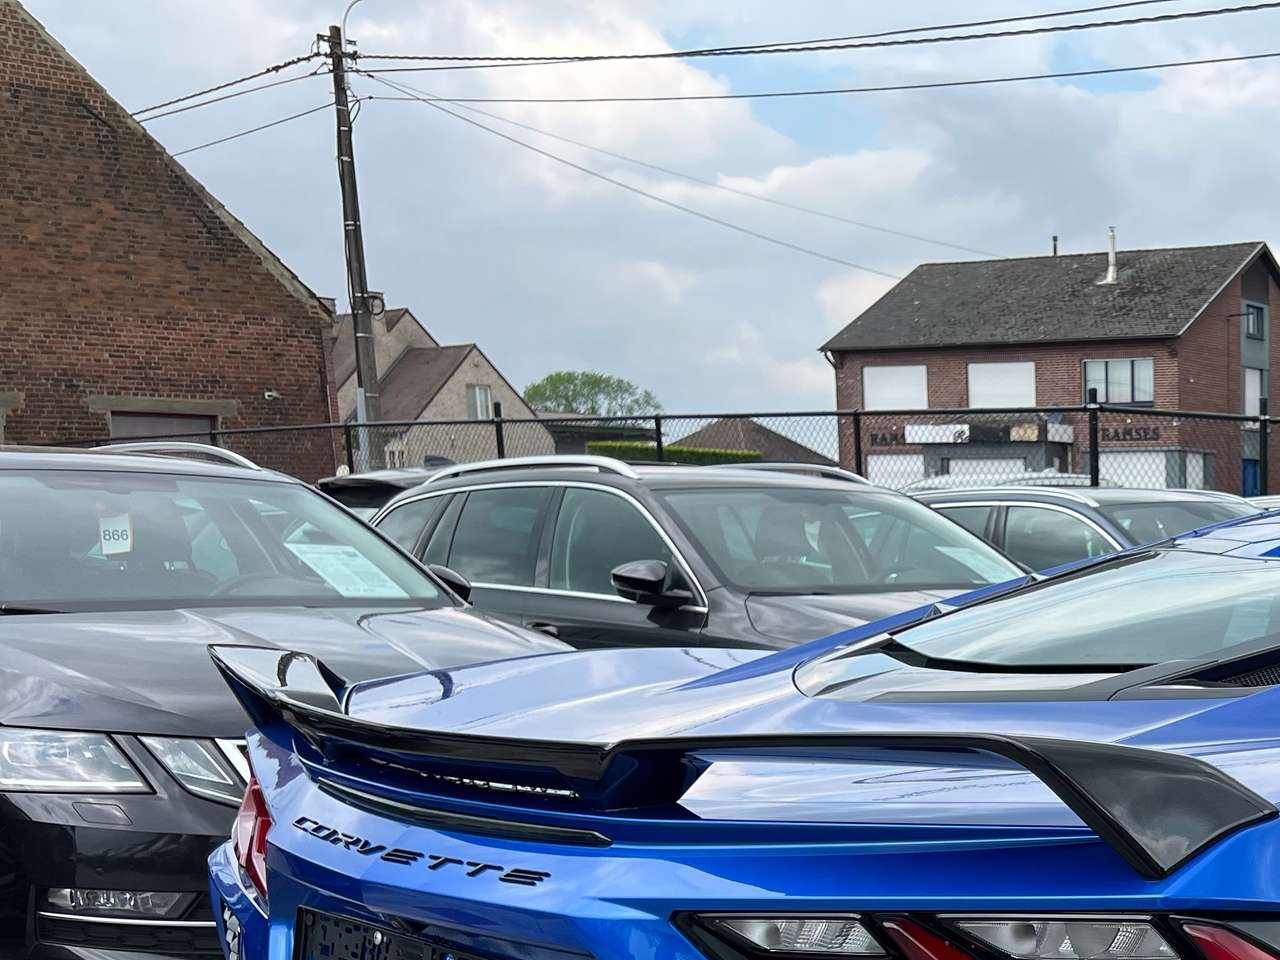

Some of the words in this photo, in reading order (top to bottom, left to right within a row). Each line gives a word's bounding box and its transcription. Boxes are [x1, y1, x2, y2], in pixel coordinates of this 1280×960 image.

[1101, 427, 1160, 442] RAMSES
[102, 529, 129, 542] 866
[292, 816, 552, 886] CORVETTE
